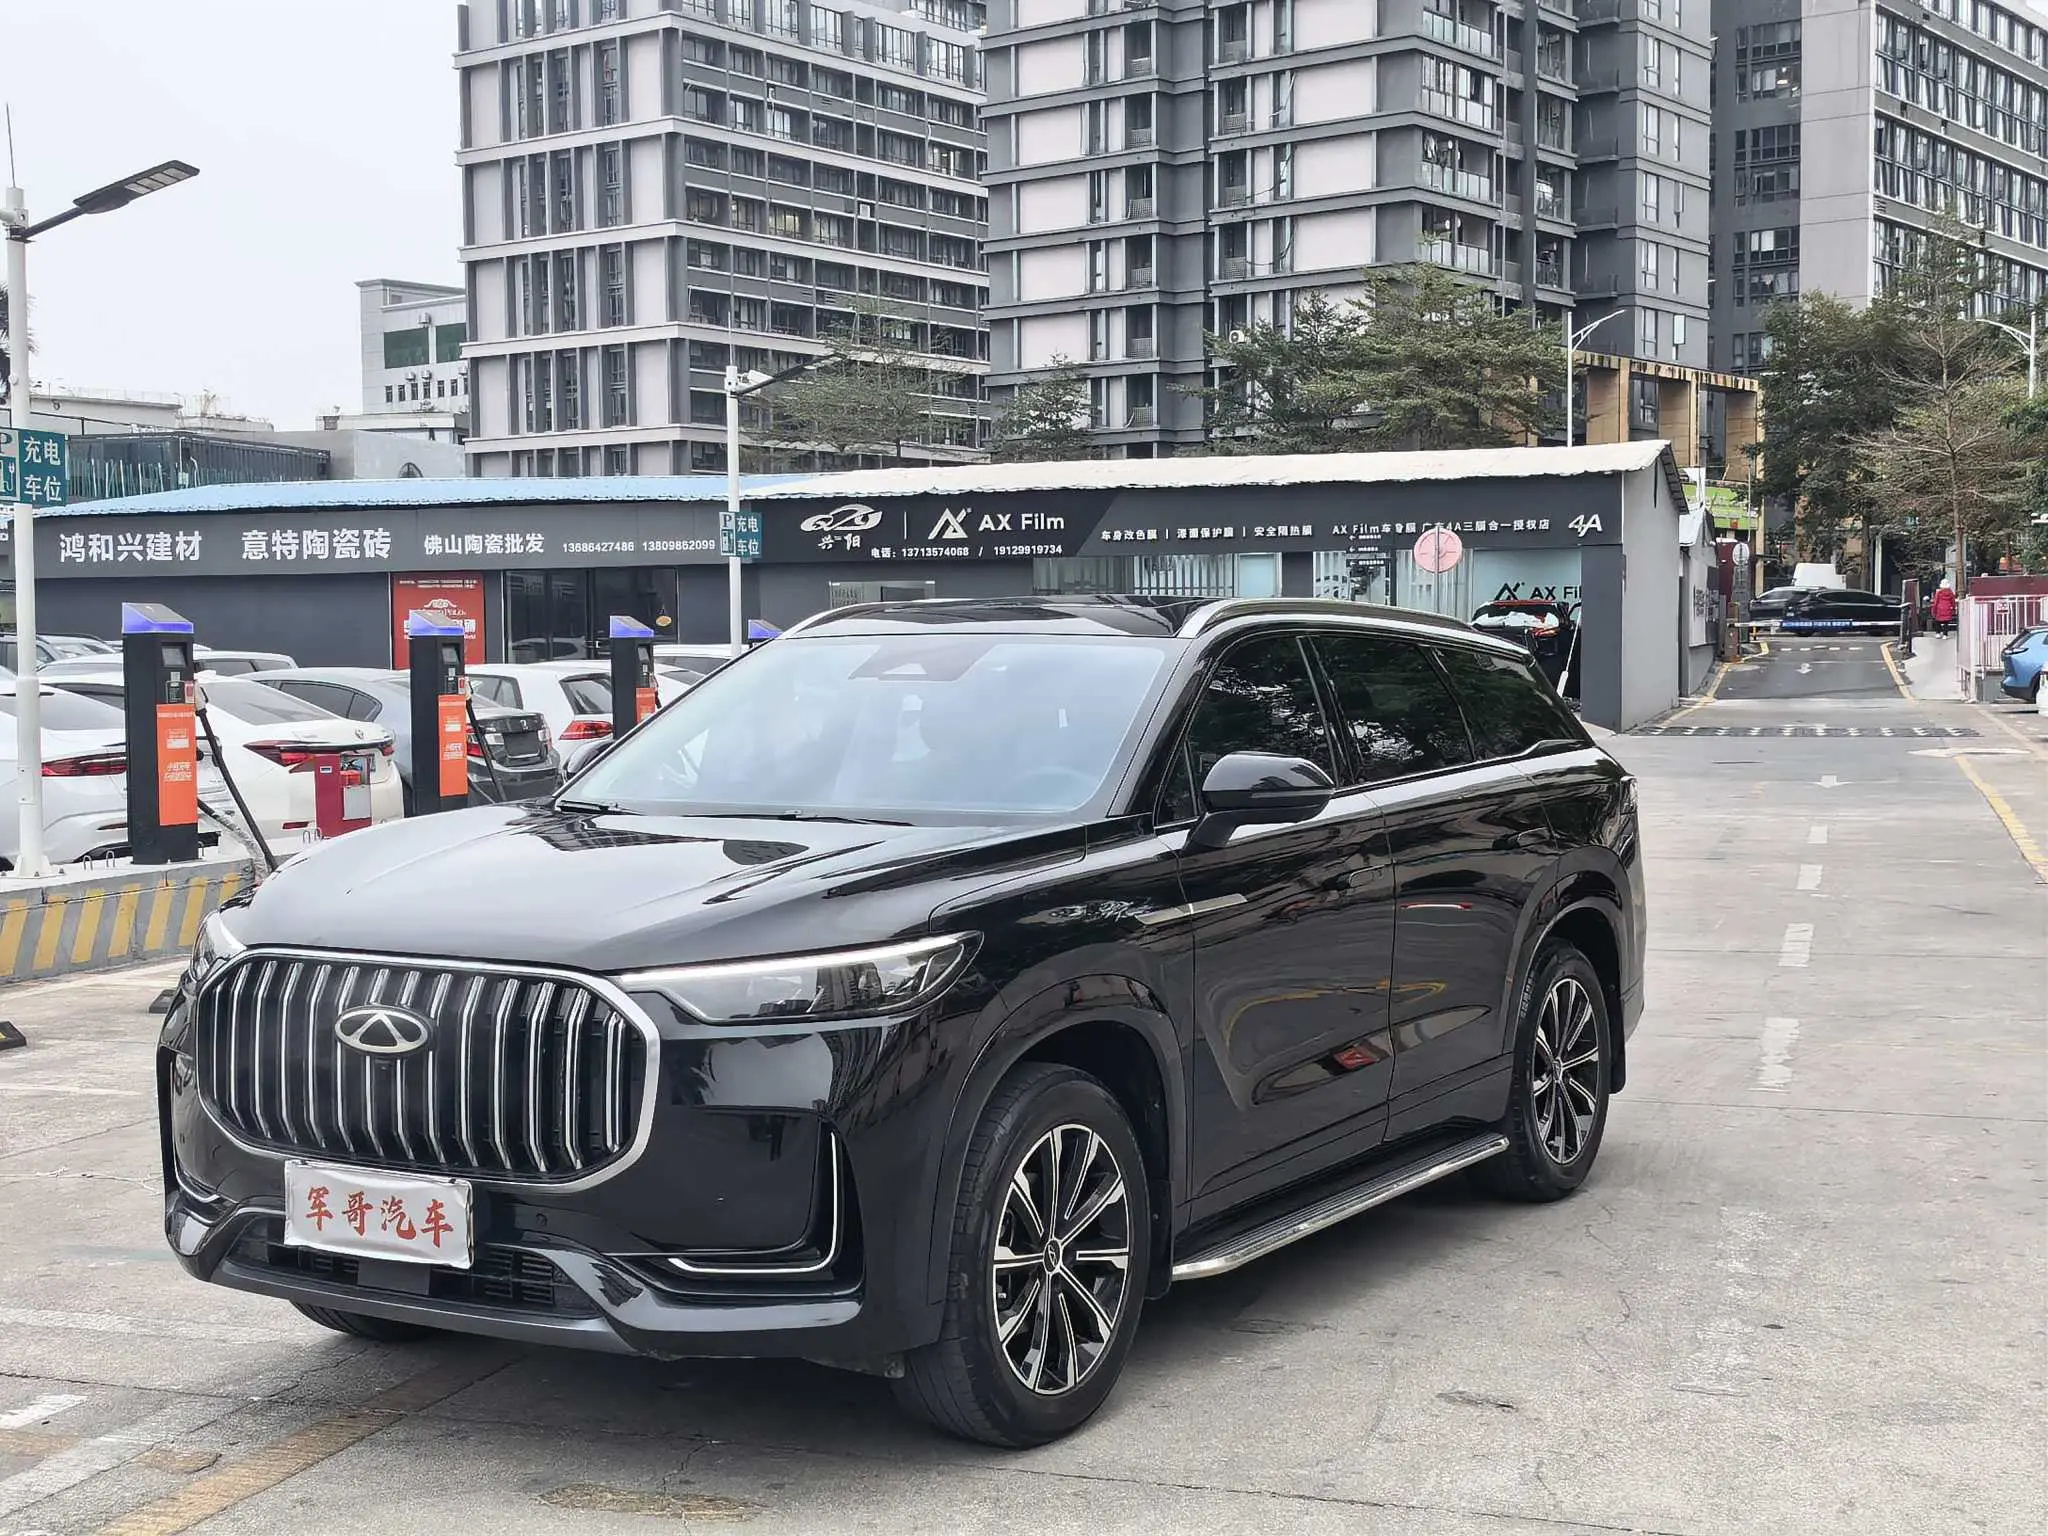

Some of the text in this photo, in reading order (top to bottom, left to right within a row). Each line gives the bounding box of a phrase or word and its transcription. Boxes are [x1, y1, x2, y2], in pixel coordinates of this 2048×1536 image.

[24, 436, 60, 465] 充电
[24, 474, 62, 502] 车位
[723, 514, 732, 528] P
[736, 516, 759, 532] 充电
[979, 513, 1064, 531] AX Film
[1254, 525, 1312, 537] 安全隔热膜
[1332, 525, 1347, 534] AX
[1568, 514, 1603, 537] 4A
[59, 532, 202, 562] 鸿和兴建材
[241, 528, 392, 560] 意特陶瓷砖
[423, 533, 545, 556] 佛山陶瓷批发
[736, 539, 760, 556] 车位
[1530, 586, 1556, 600] AX
[306, 1186, 453, 1248] 军哥汽车
